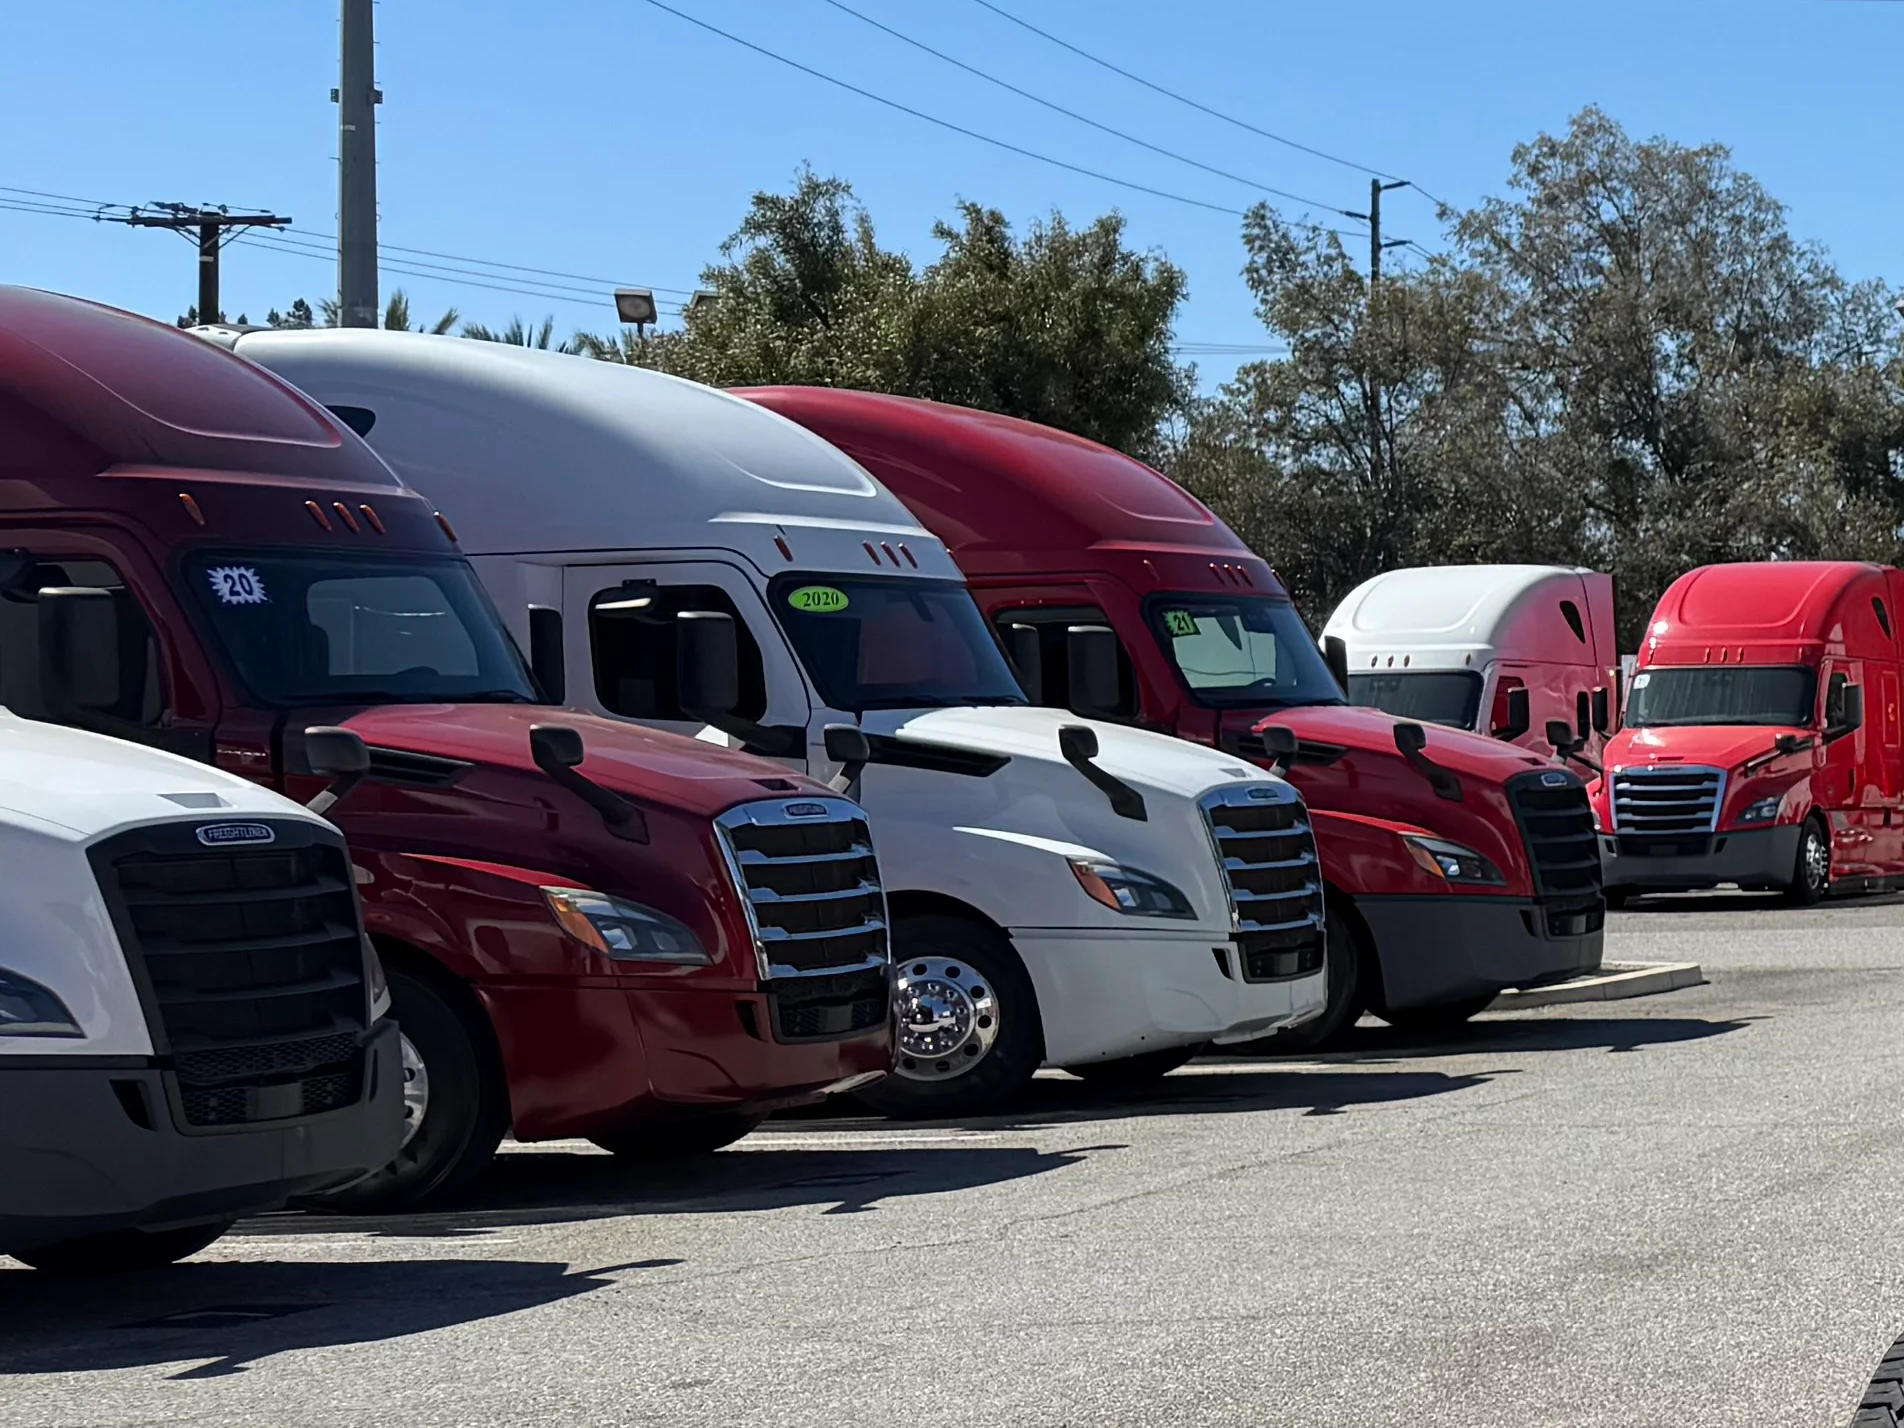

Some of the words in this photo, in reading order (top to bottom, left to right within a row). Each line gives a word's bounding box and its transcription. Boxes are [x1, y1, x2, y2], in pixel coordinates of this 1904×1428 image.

[223, 573, 254, 597] 20
[801, 592, 840, 607] 2020
[1173, 614, 1190, 631] 21
